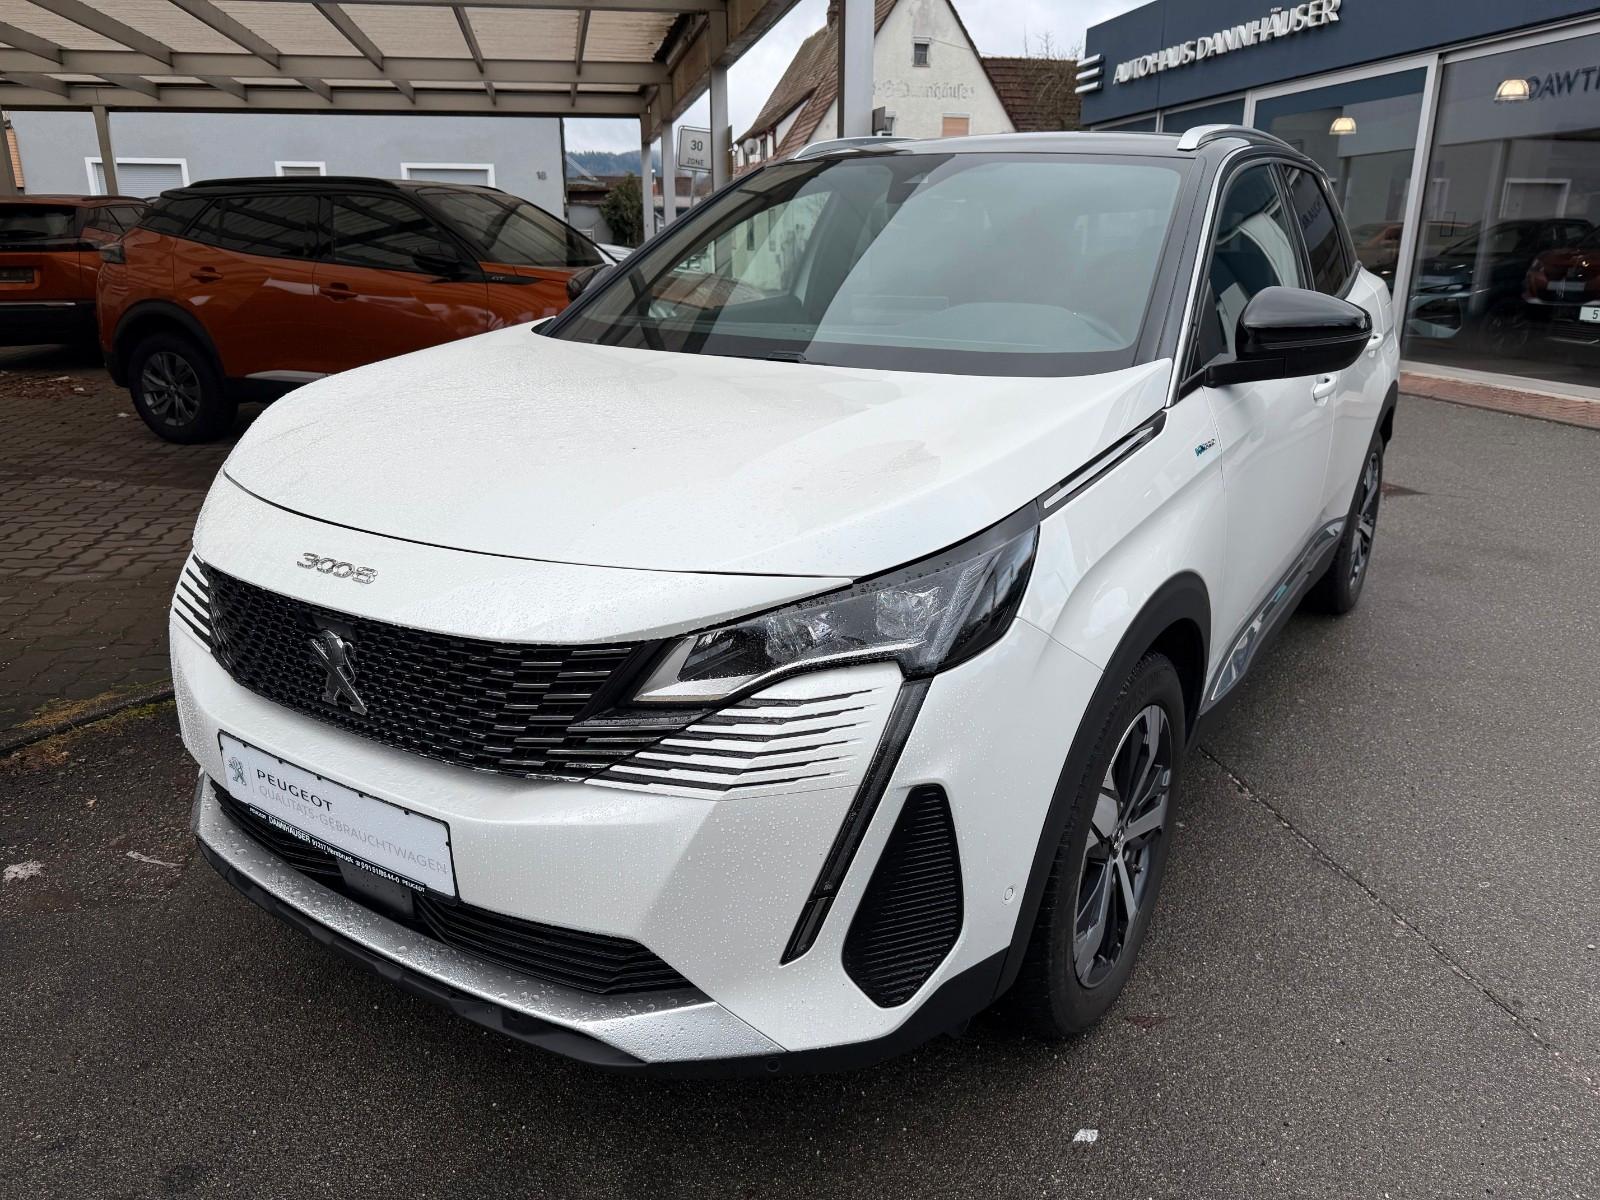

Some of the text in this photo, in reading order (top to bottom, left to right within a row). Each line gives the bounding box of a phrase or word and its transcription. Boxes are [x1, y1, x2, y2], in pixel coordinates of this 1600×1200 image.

[1112, 0, 1342, 85] AUTOHAUS DANNHÄUSER
[690, 139, 703, 152] 30
[296, 552, 379, 584] 3008
[256, 768, 333, 812] PEUGEOT
